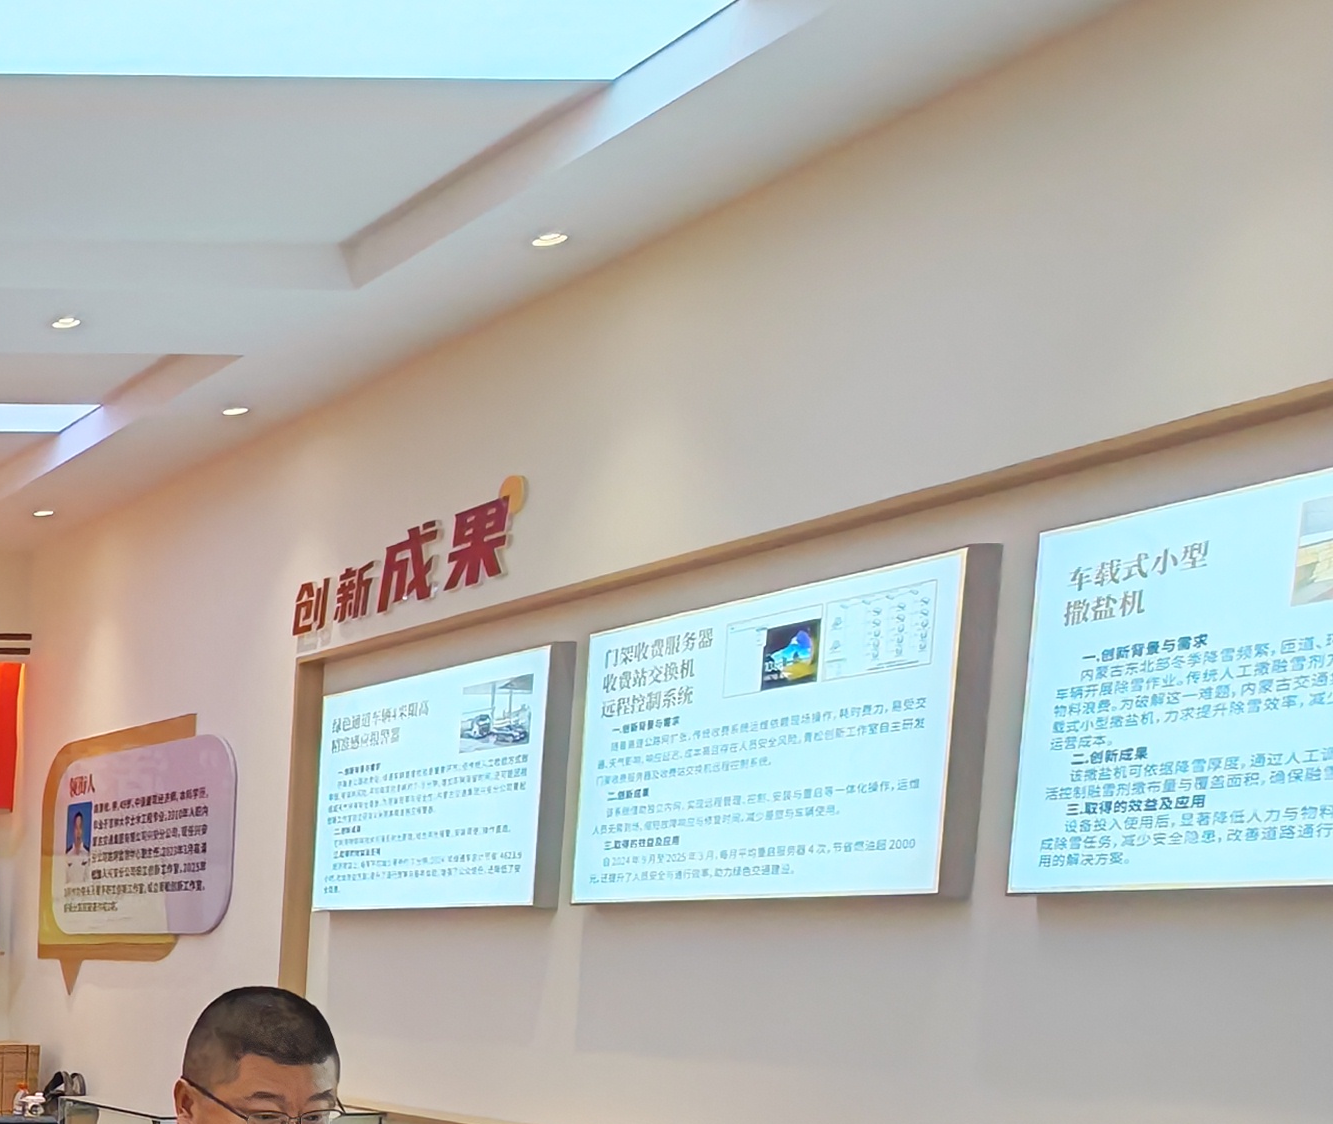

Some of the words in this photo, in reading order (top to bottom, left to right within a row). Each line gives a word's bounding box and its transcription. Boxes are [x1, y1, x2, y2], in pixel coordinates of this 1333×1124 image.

[292, 495, 511, 636] 创新成果
[1067, 540, 1211, 591] 车载式小型
[1062, 588, 1146, 628] 撒盐机
[604, 628, 714, 669] 门架收费服务器
[602, 658, 695, 694] 收费站交换机
[601, 685, 694, 718] 远程控制系统
